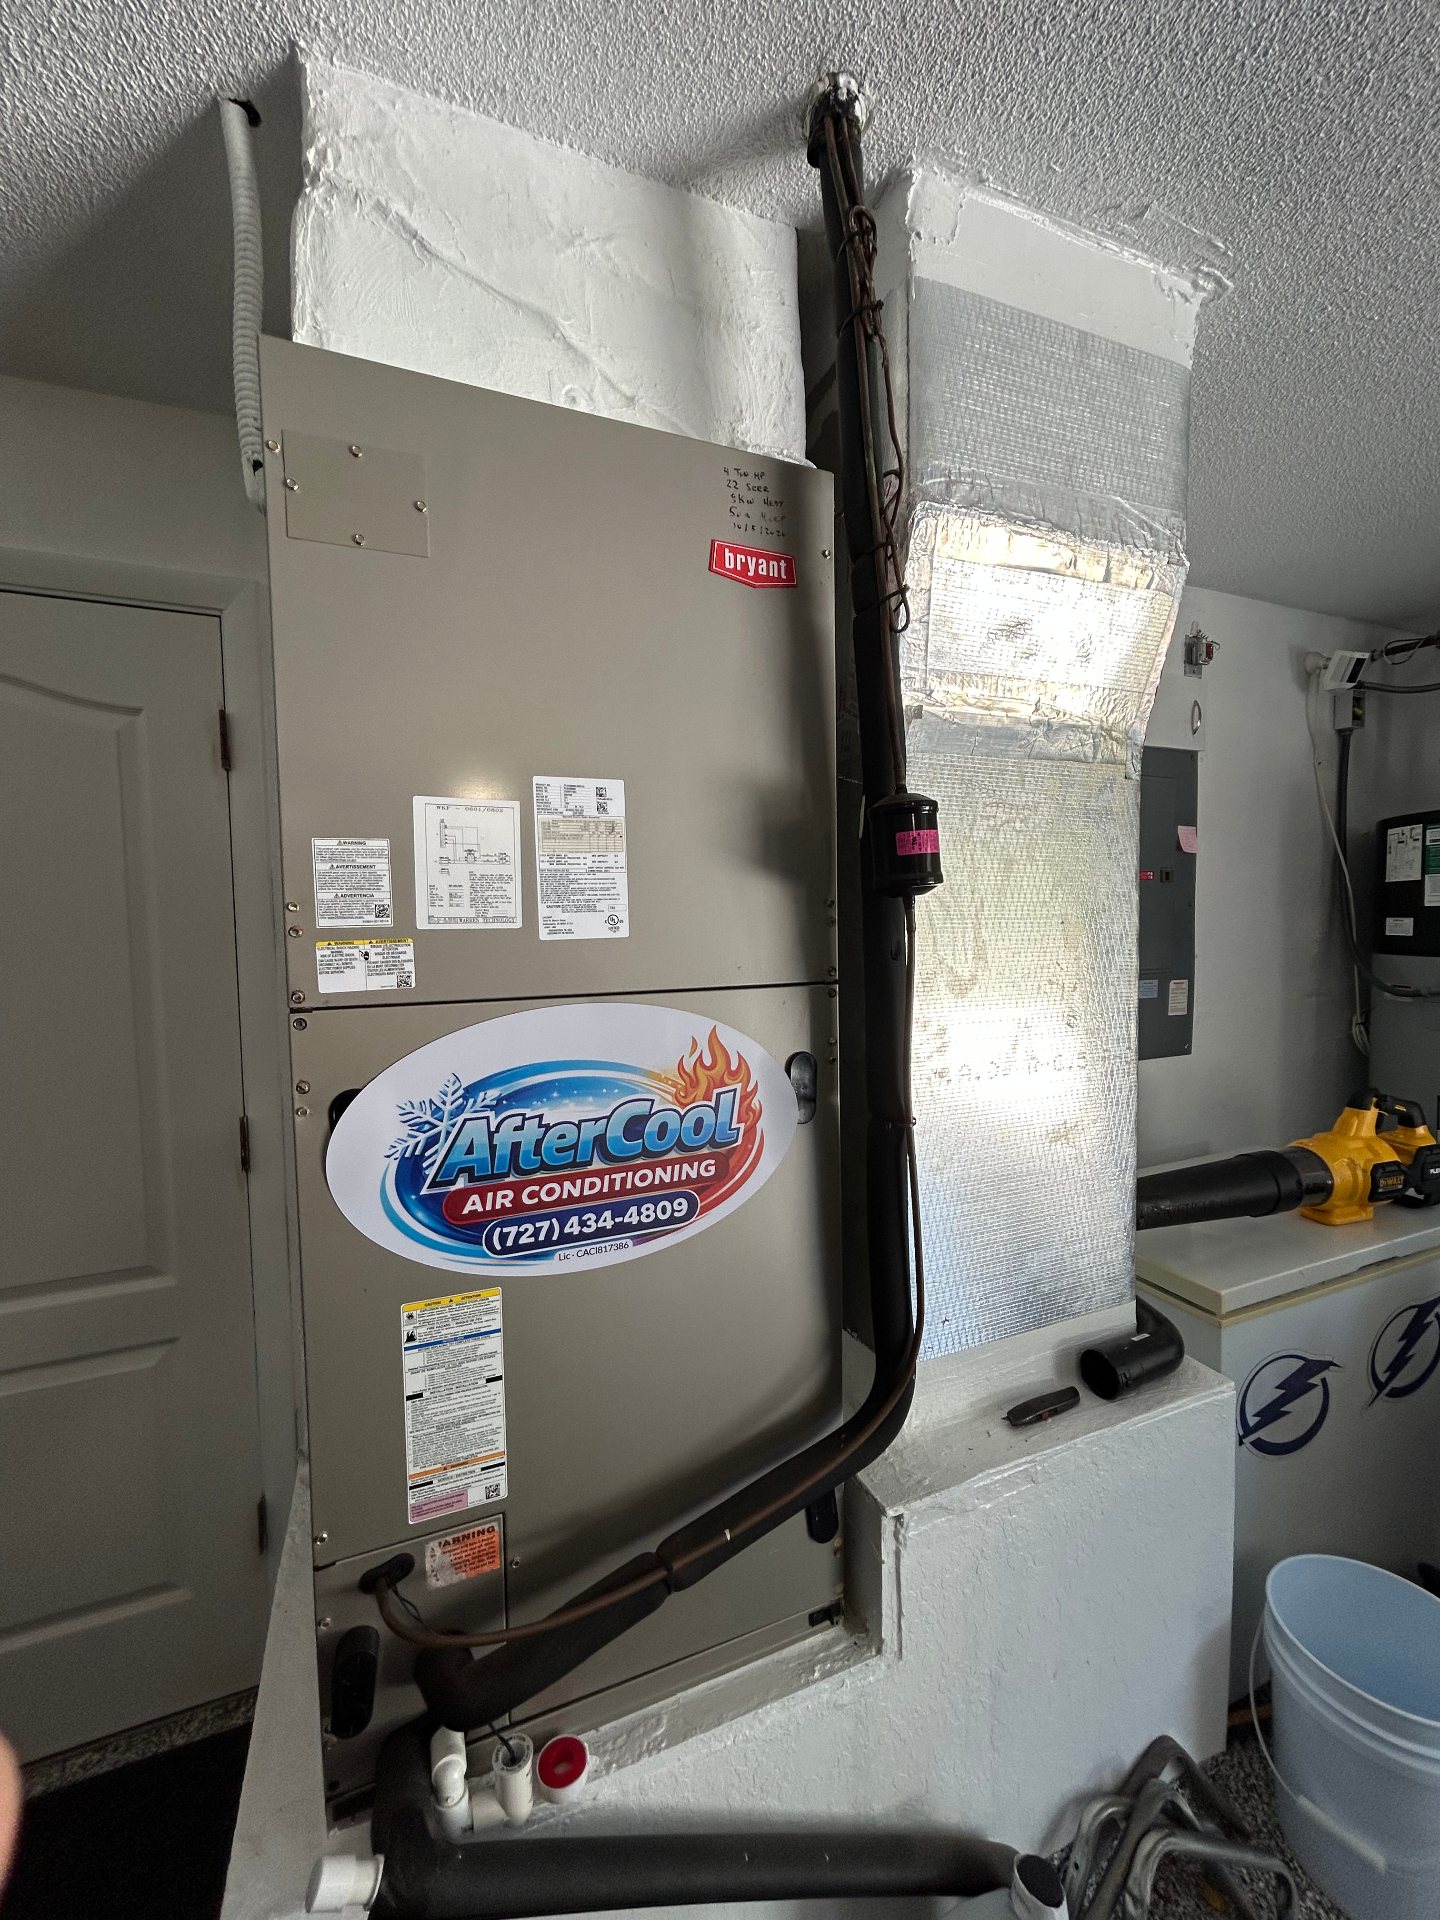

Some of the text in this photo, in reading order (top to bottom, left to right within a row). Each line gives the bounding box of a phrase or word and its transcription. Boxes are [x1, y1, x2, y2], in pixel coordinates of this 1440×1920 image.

[727, 479, 739, 490] 22
[724, 548, 787, 579] bryant
[428, 1088, 740, 1188] AfterCool
[462, 1159, 716, 1214] AIR CONDITIONING
[492, 1198, 689, 1251] (727) 434-4809
[559, 1253, 570, 1261] Lic
